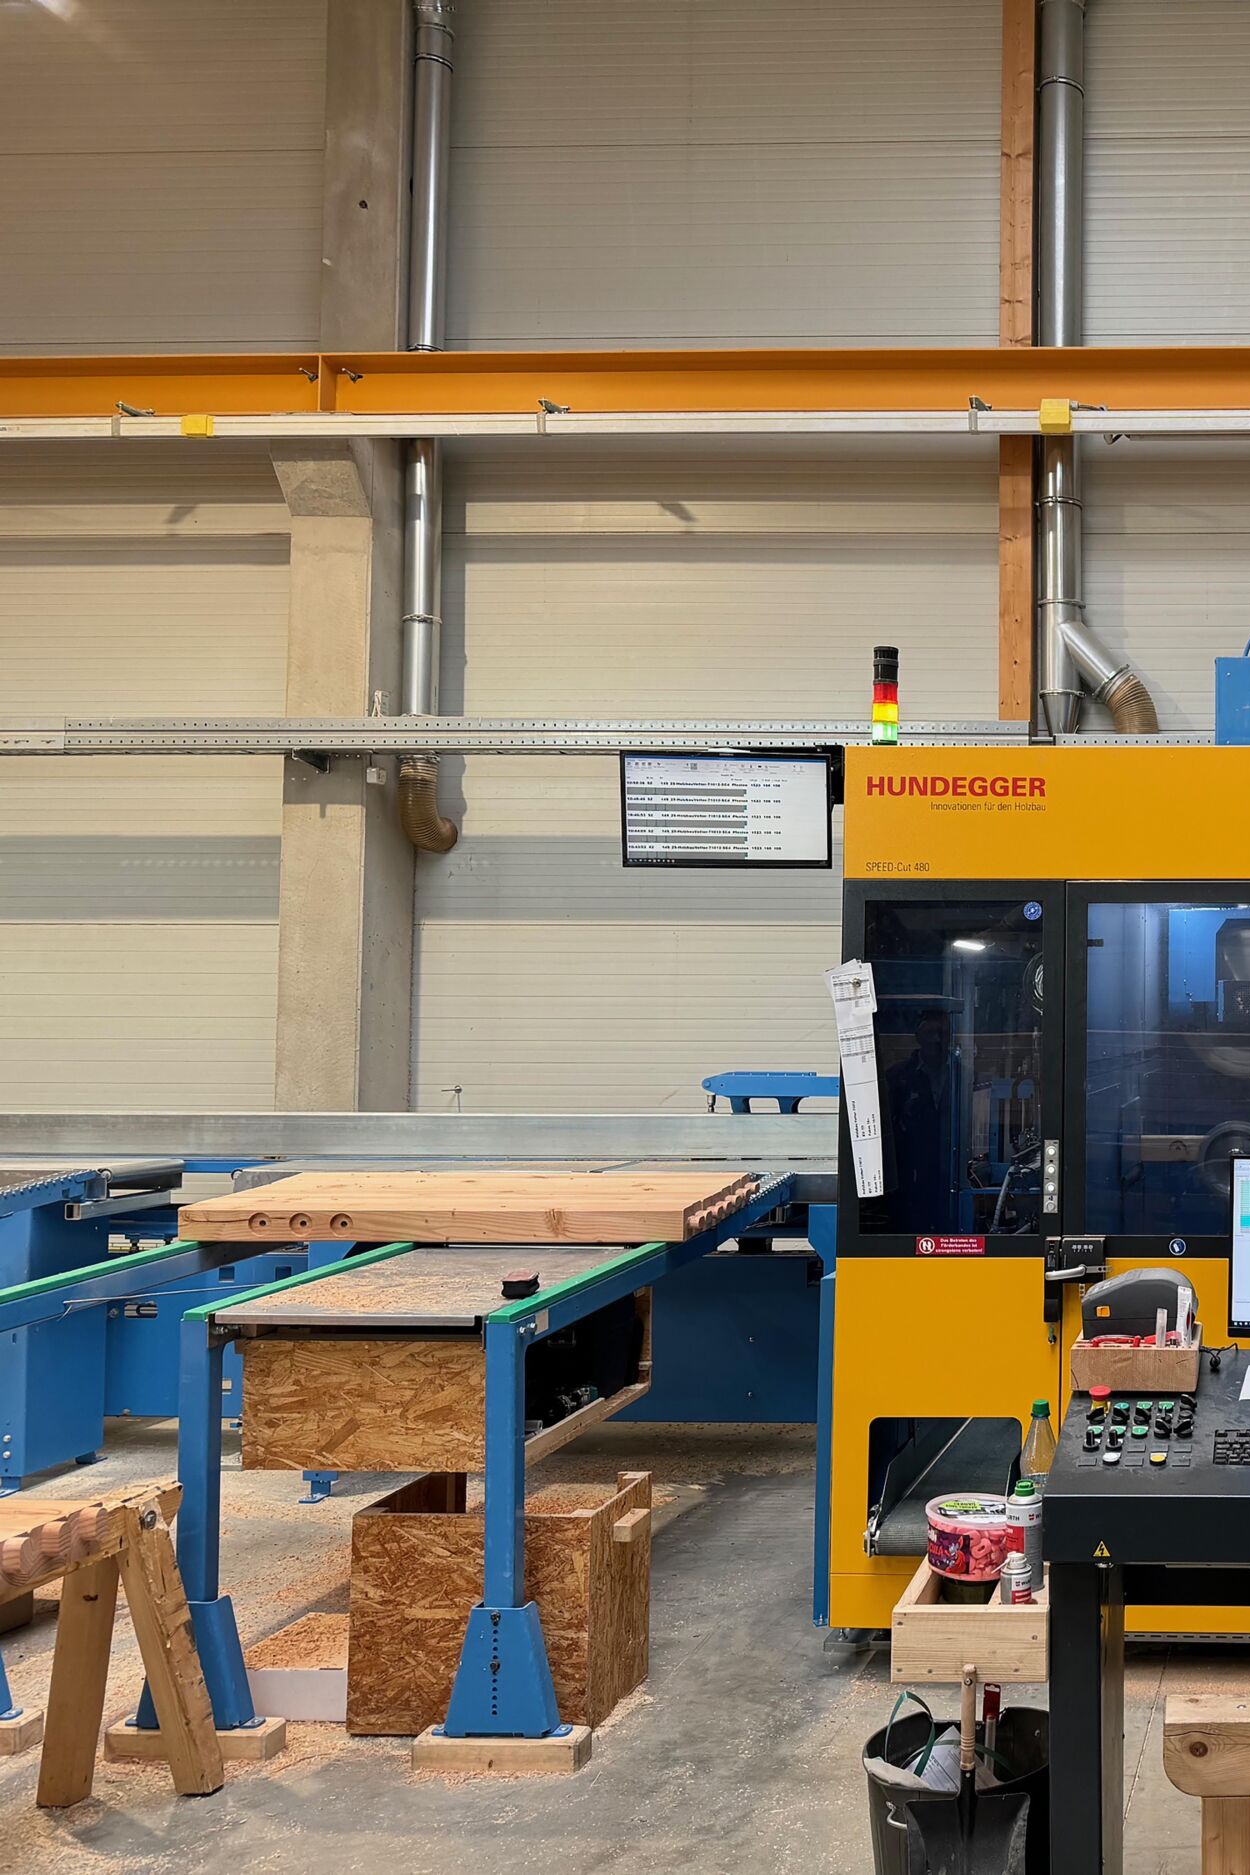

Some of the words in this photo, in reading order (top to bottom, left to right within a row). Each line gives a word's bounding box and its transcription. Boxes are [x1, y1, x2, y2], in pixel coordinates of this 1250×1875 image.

[866, 776, 1046, 797] HUNDEGGER
[930, 802, 981, 811] Innovationen
[984, 801, 995, 811] für
[997, 802, 1012, 811] den
[1015, 802, 1046, 811] Holzbau
[866, 862, 911, 871] SPEED-Cut
[914, 862, 930, 871] 480
